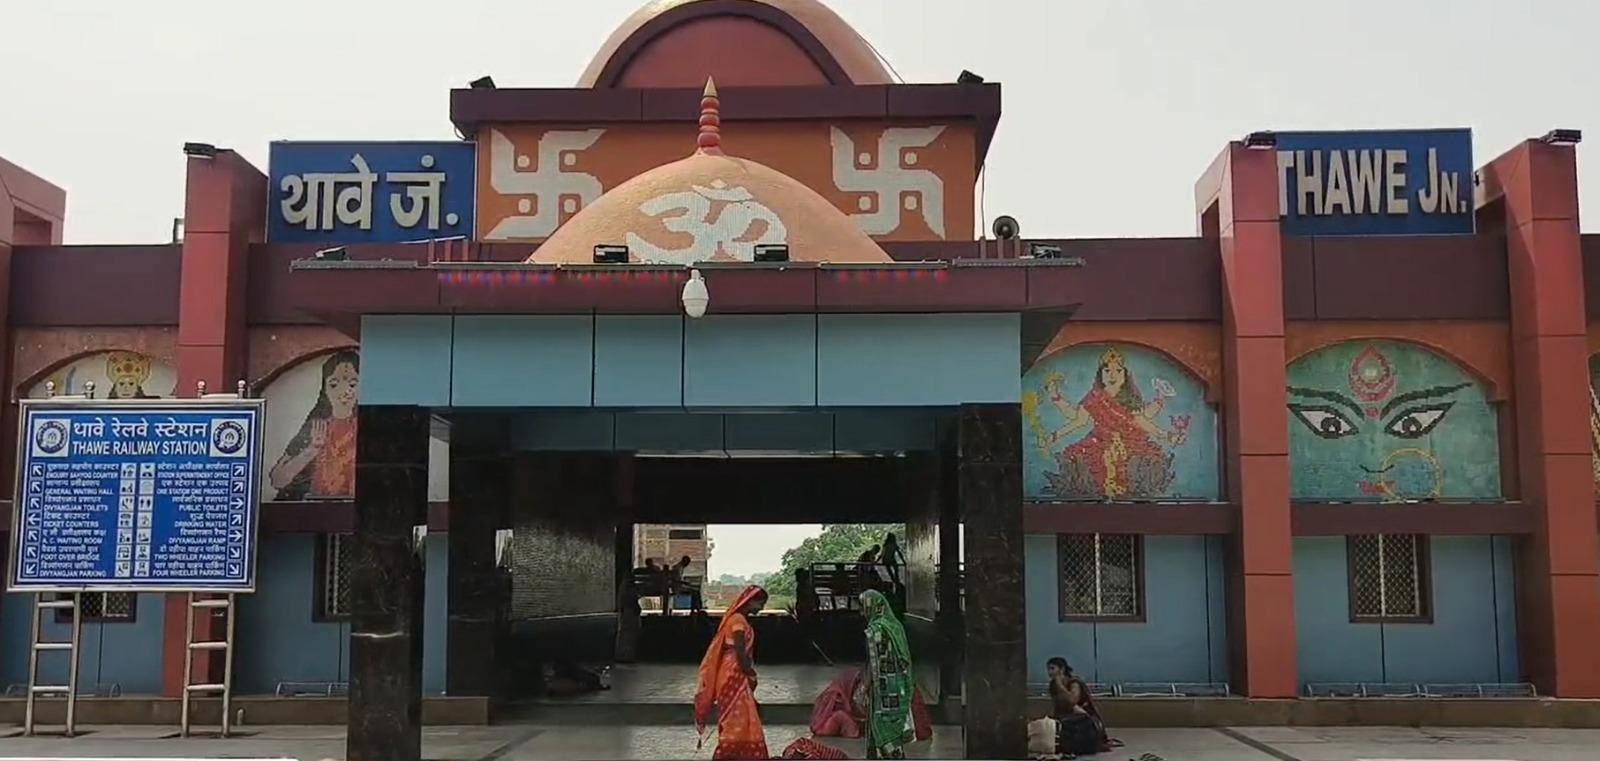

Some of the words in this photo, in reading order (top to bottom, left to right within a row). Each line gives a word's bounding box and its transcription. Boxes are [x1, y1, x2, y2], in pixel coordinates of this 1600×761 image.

[1276, 149, 1410, 217] THAWE
[281, 153, 378, 229] थावे
[386, 154, 459, 229] जं.
[73, 418, 105, 437] थावे
[111, 418, 149, 437] रेलवे
[154, 418, 208, 437] स्टेशन
[72, 441, 109, 455] THAWE
[112, 441, 160, 455] RAILWAY
[162, 441, 207, 455] STATION
[43, 504, 82, 512] DIVYANGJAN
[83, 504, 109, 512] TOILETS
[178, 504, 202, 512] PUBLIC
[202, 504, 228, 512] TOILETS
[40, 569, 78, 577] DIVYANGJAN
[78, 569, 107, 577] PARKING
